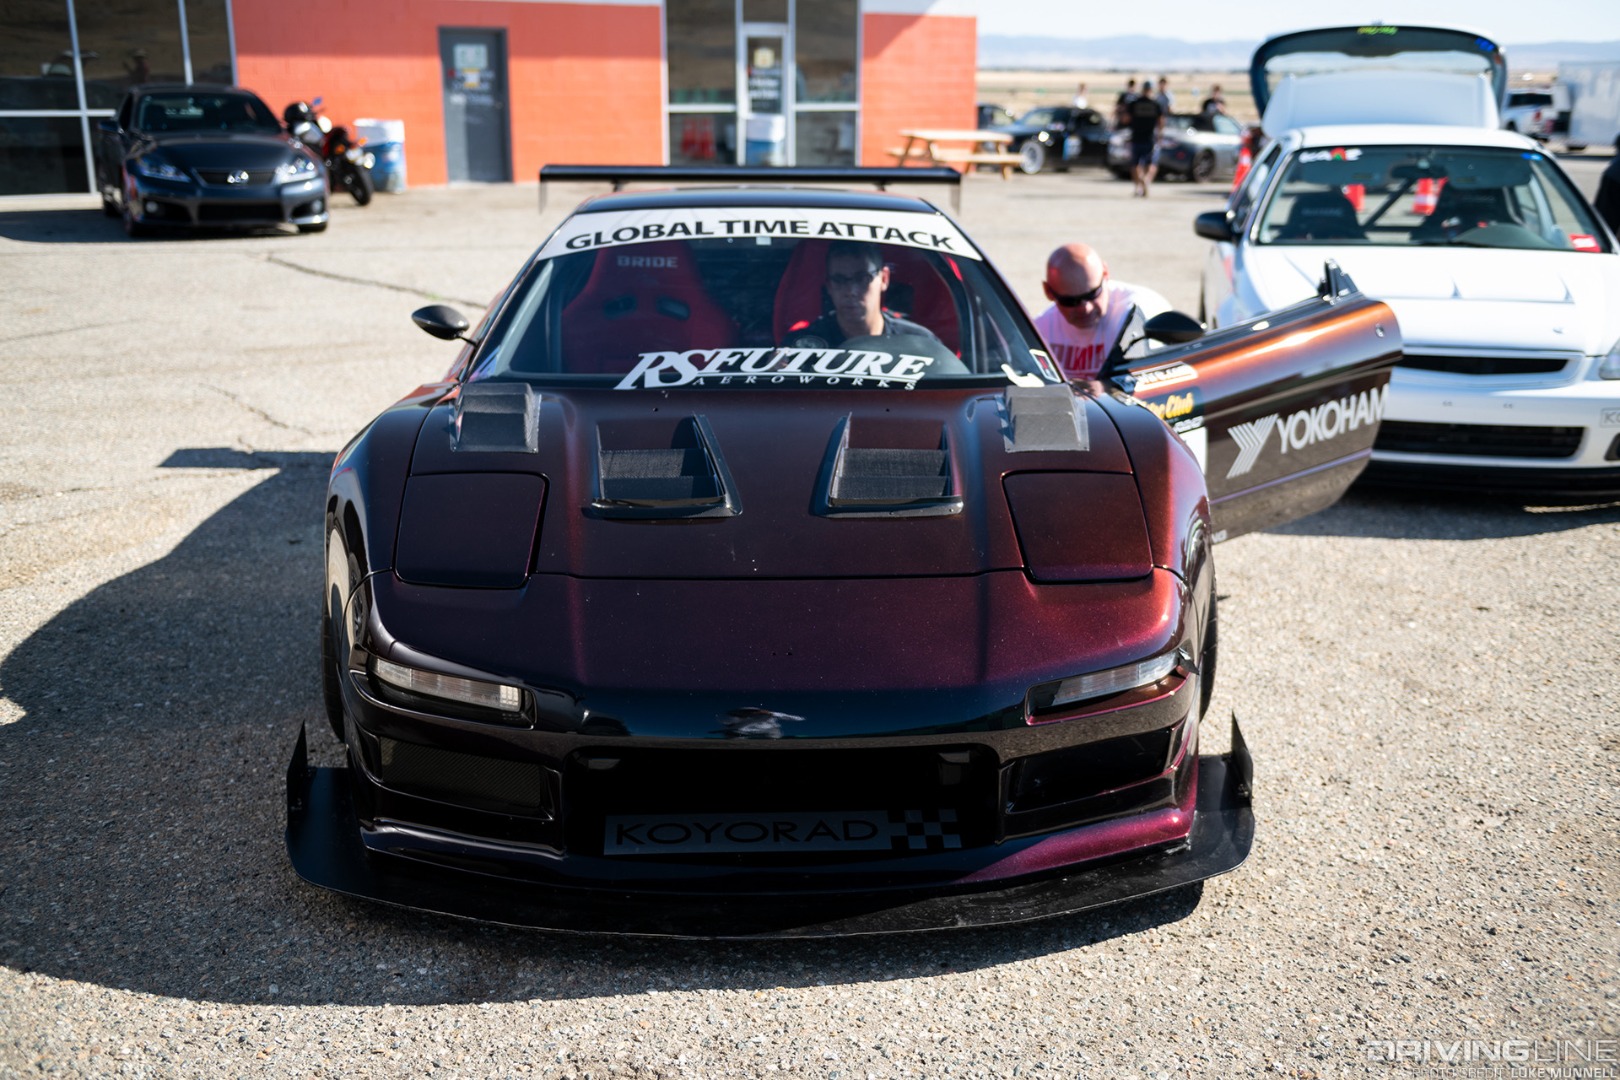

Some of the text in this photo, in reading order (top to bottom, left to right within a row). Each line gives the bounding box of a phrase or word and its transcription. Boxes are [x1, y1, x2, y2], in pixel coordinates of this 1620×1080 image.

[566, 220, 955, 251] GLOBAL TIME ATTACK
[617, 255, 678, 269] BRIDE
[692, 375, 918, 391] AEROWORKS
[616, 819, 879, 846] KOYORAD
